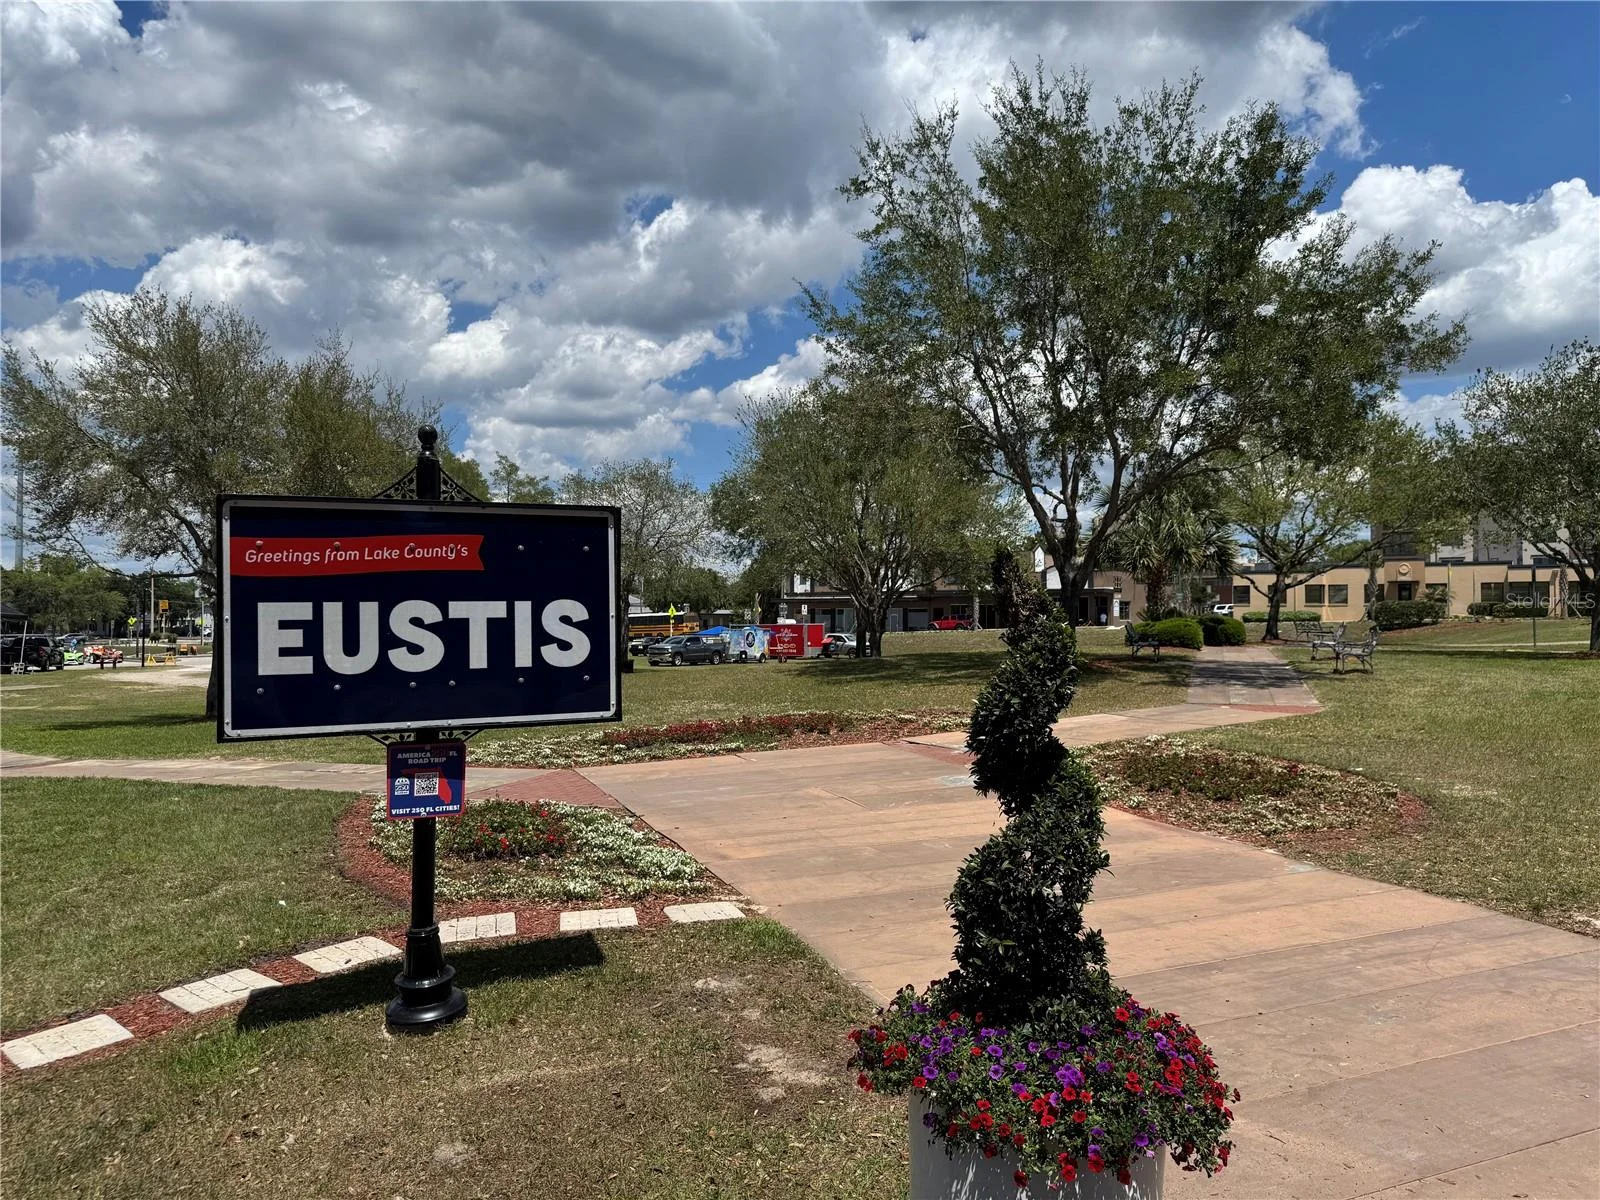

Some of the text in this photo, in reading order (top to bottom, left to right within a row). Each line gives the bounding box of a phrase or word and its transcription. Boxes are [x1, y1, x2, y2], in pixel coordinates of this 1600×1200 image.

[245, 544, 469, 566] Greetings from Lake County's
[257, 599, 591, 676] EUSTIS
